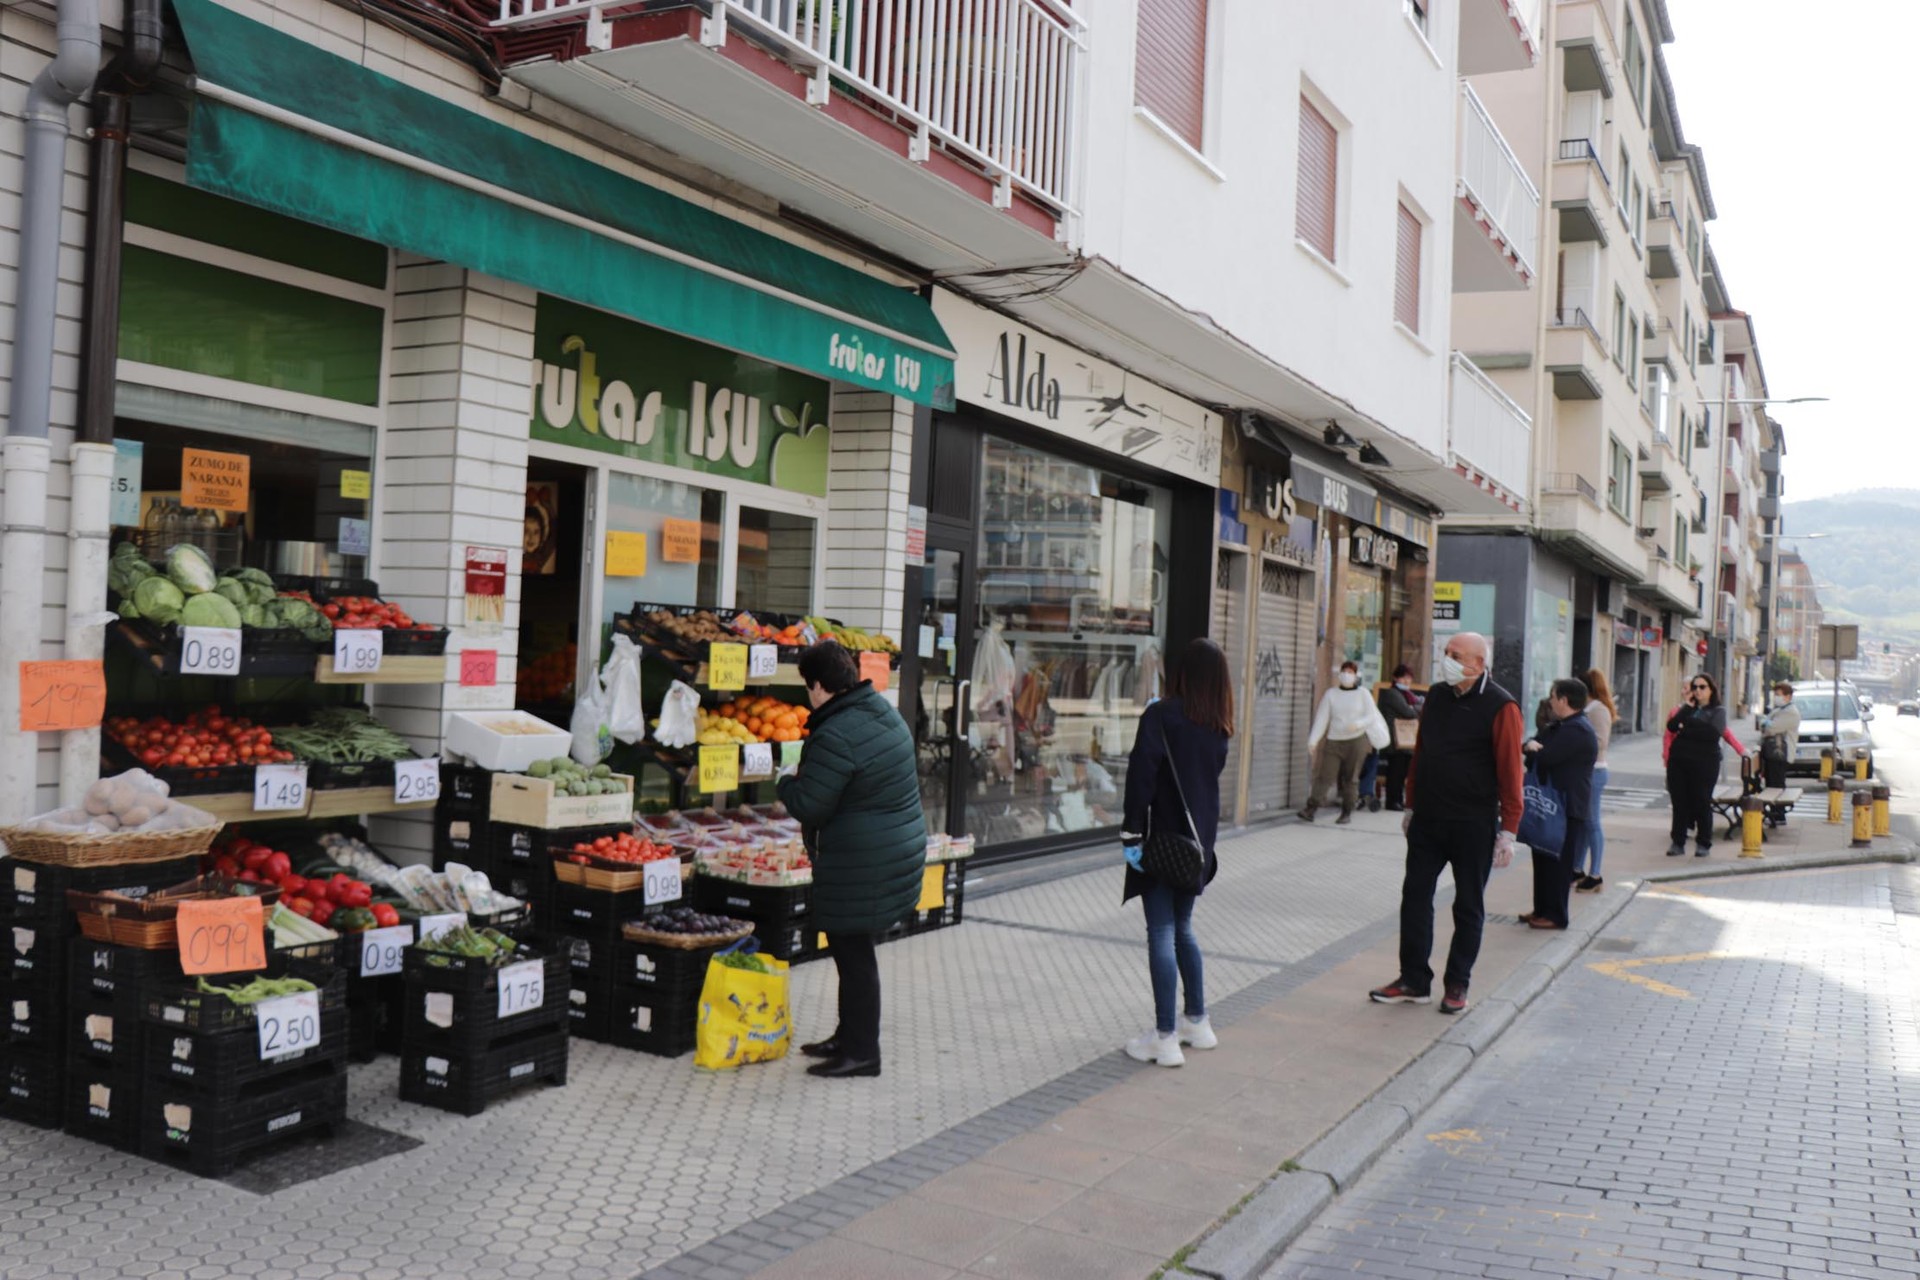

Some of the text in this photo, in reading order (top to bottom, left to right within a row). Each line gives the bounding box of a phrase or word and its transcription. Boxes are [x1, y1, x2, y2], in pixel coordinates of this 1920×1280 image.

[829, 333, 921, 392] frutas ISU
[983, 331, 1060, 420] Alda
[689, 381, 760, 468] ISU
[190, 456, 244, 472] ZUMO DE
[190, 471, 243, 488] NARANJA
[1323, 477, 1349, 513] BUS
